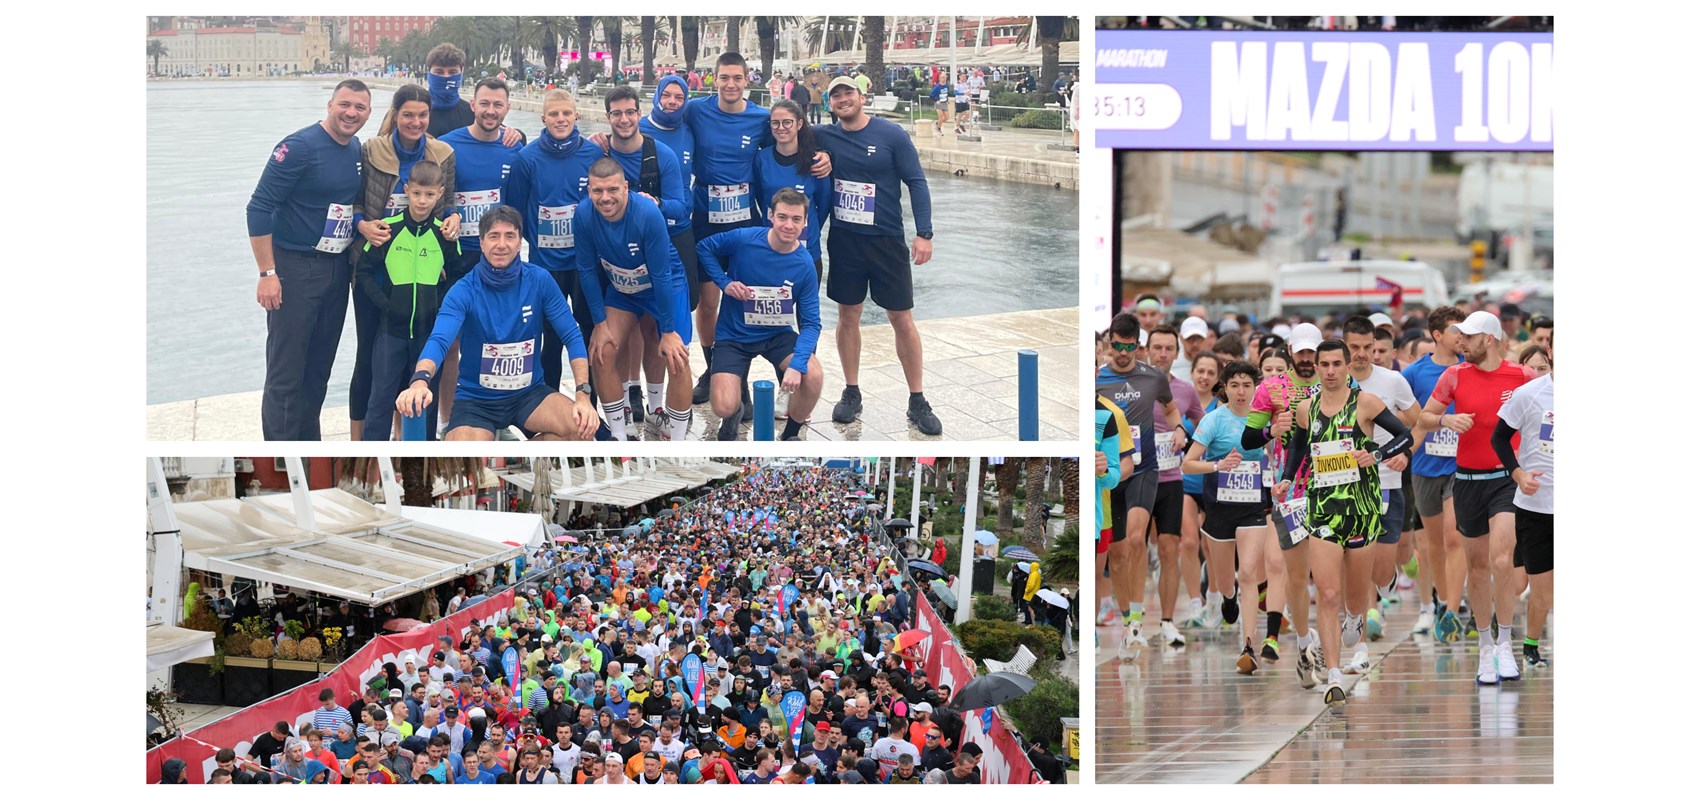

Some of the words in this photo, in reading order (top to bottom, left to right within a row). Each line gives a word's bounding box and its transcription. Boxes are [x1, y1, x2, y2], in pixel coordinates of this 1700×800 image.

[1095, 49, 1169, 68] MARATHON
[1211, 41, 1437, 142] MAZDA
[719, 197, 741, 212] 1104
[838, 193, 866, 212] 4046
[550, 218, 573, 236] 1181
[611, 273, 639, 286] 1425
[754, 299, 782, 315] 4156
[491, 356, 524, 376] 4009
[1432, 425, 1459, 445] 4585
[1316, 453, 1351, 473] ŽIVKOVIĆ
[1226, 472, 1254, 490] 4549
